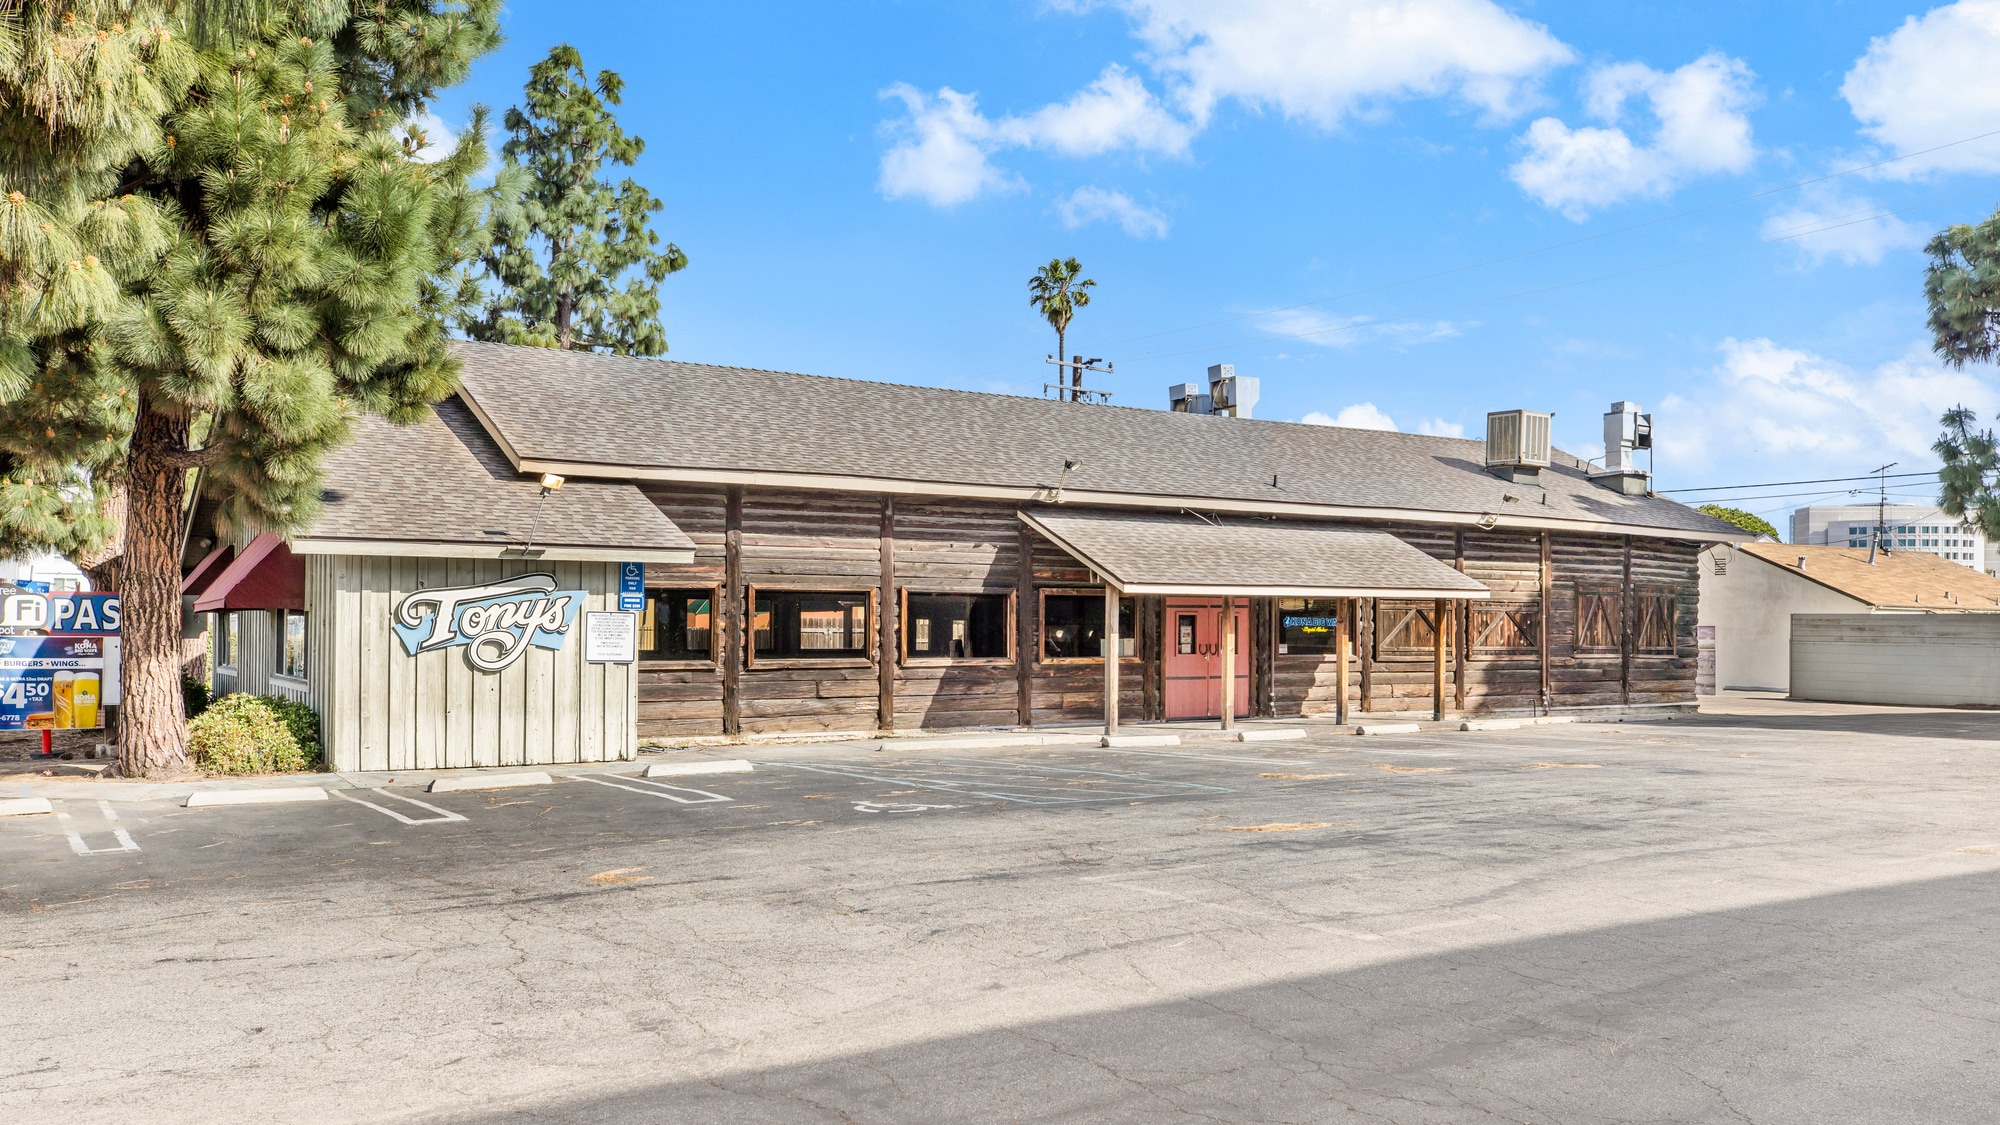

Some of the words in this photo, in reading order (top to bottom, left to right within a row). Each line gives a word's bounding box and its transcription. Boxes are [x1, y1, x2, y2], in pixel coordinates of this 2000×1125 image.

[16, 599, 41, 621] Fi
[400, 573, 569, 672] Tonys
[1291, 617, 1312, 626] KONA
[1313, 617, 1325, 626] BIG
